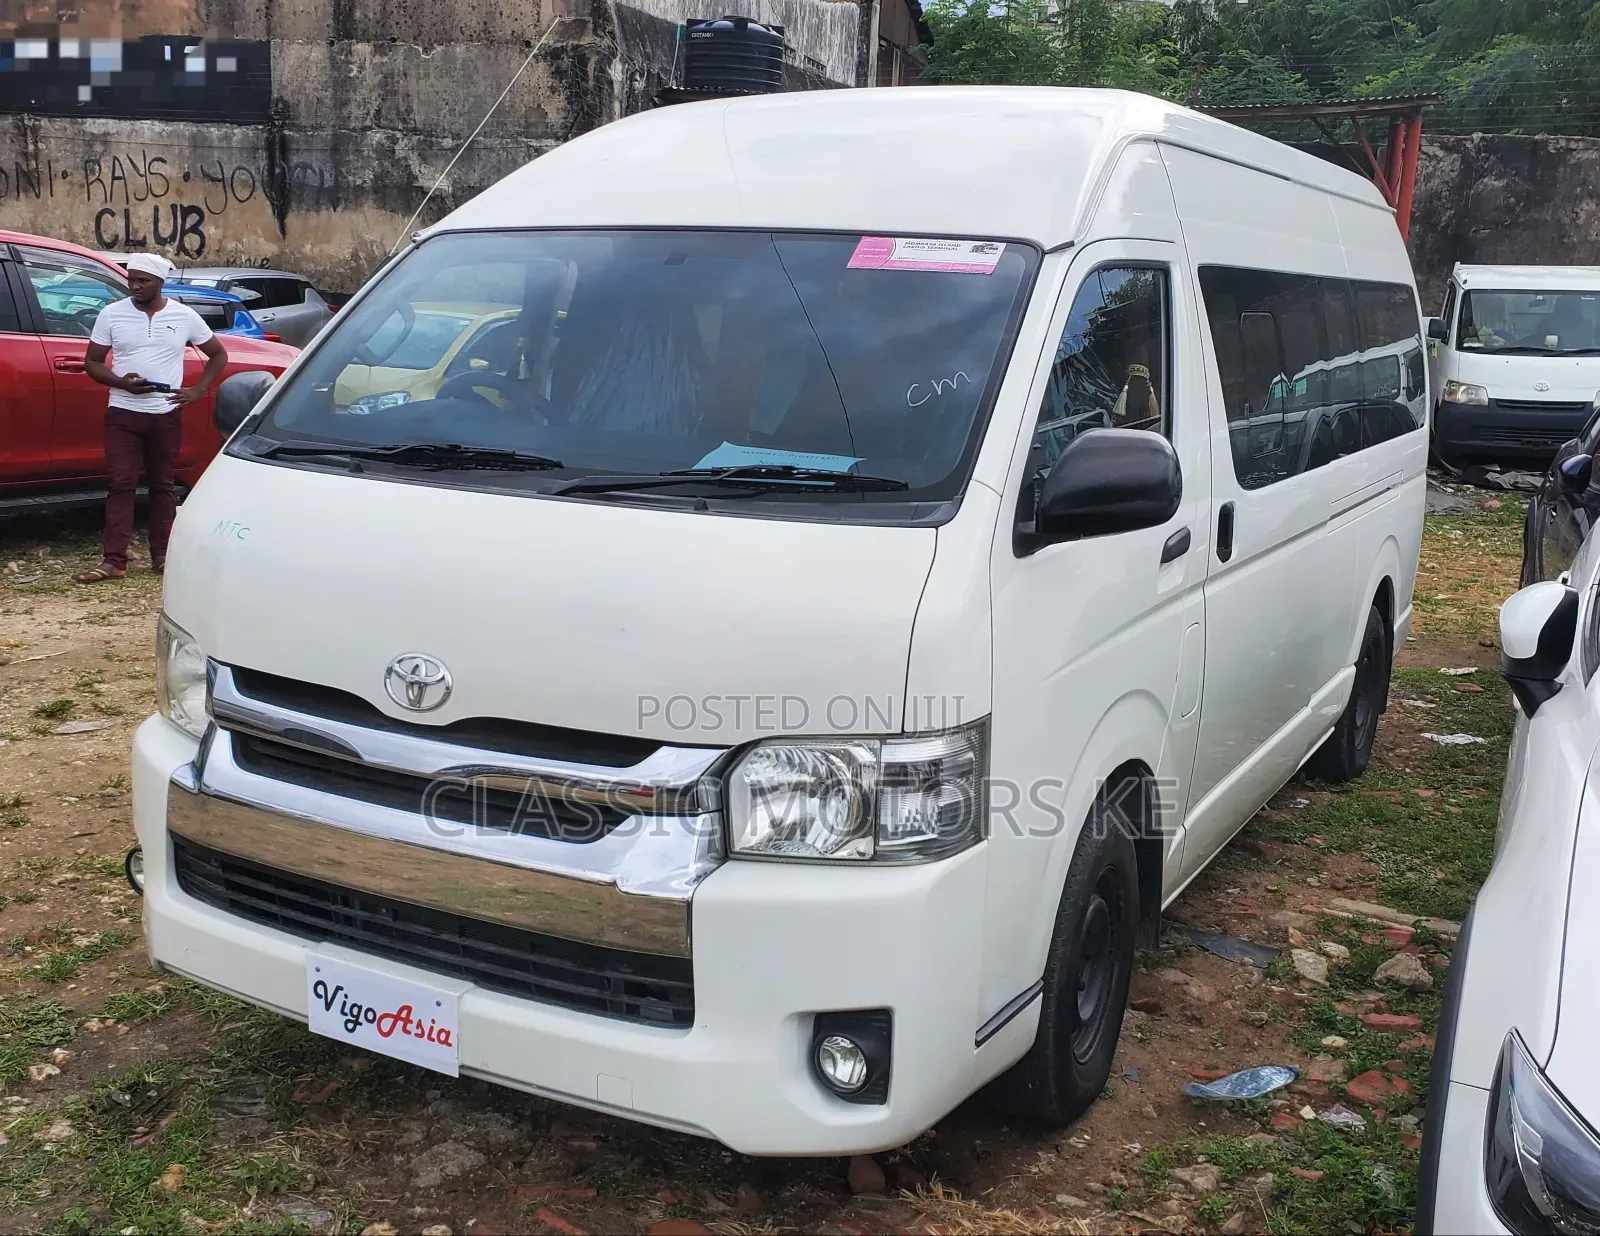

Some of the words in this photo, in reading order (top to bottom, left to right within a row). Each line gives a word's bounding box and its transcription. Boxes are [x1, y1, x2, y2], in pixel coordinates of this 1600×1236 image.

[84, 150, 169, 204] RAYS
[95, 203, 206, 259] CLUB
[313, 979, 453, 1048] VigoAsia
